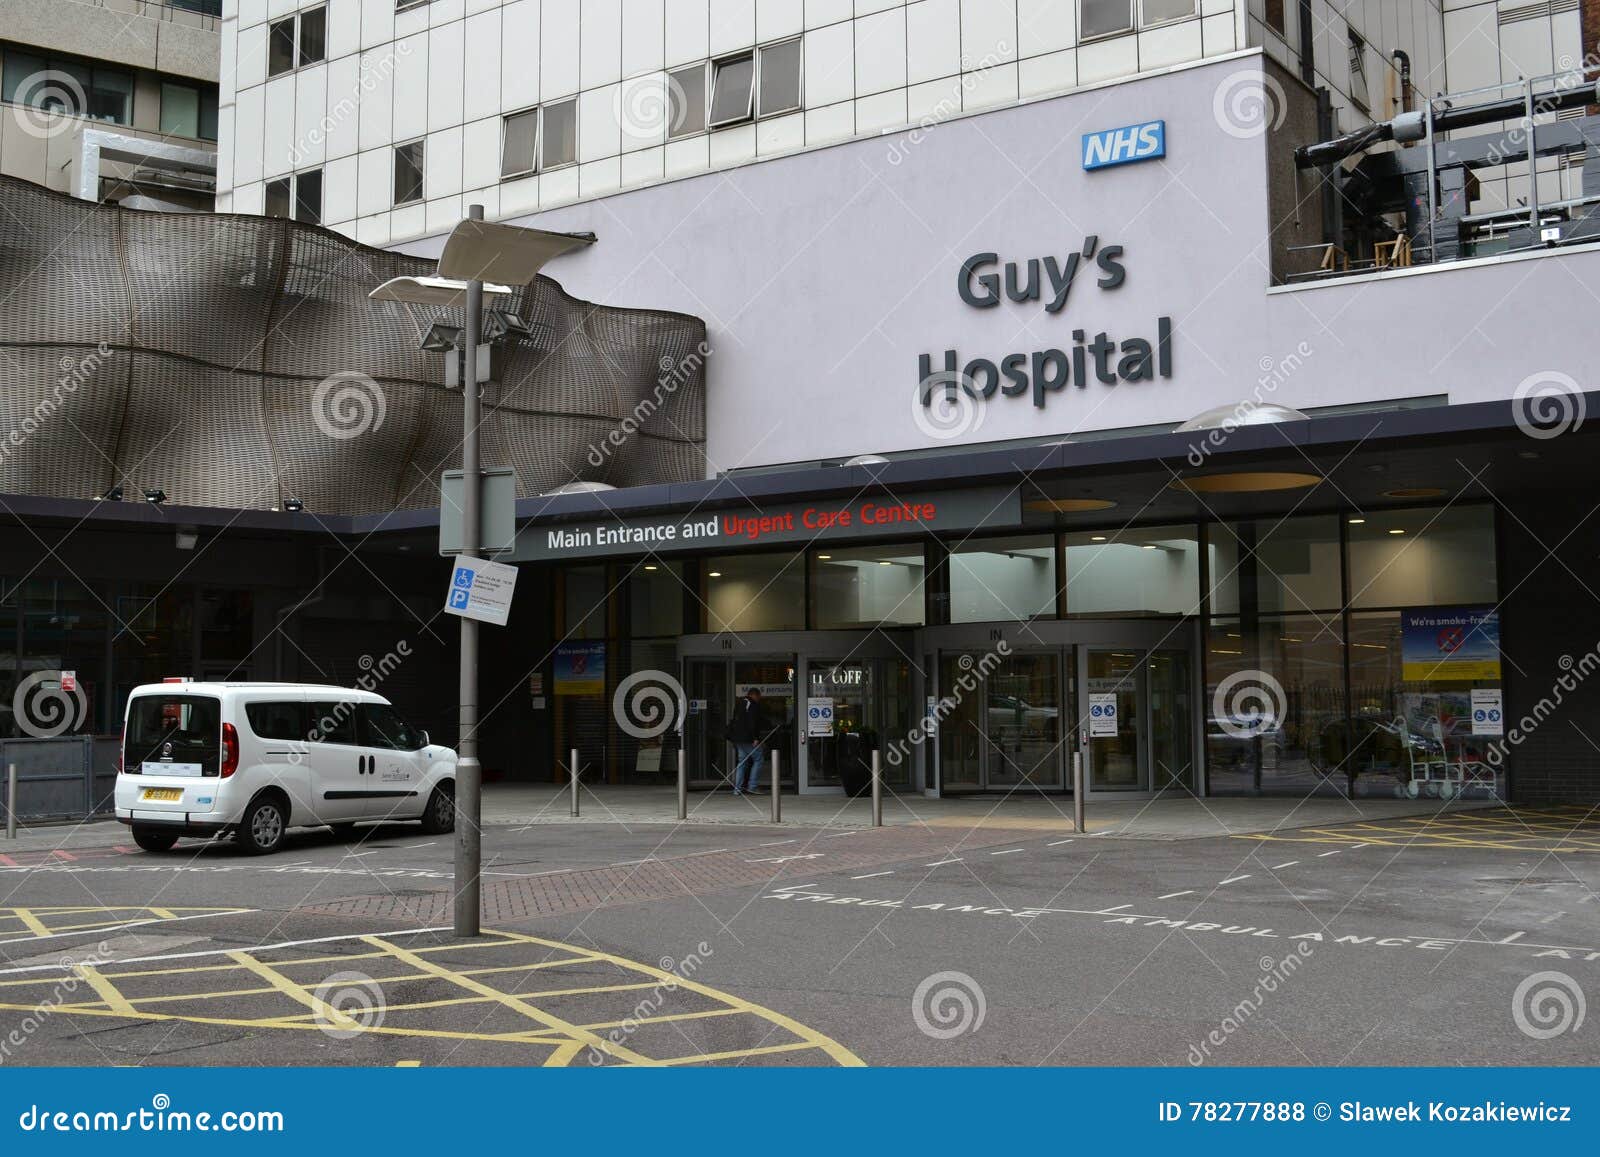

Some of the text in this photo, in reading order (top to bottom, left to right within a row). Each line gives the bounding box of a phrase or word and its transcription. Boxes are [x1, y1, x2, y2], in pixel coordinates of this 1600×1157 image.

[1083, 123, 1160, 165] NHS
[957, 235, 1127, 314] Guy's
[918, 316, 1173, 409] Hospital
[547, 501, 937, 549] Main Entrance and Urgent Care Centre
[990, 629, 1002, 640] IN
[1410, 616, 1435, 626] We're
[722, 639, 732, 650] IN
[762, 893, 1044, 918] AMBULANCE
[1103, 917, 1458, 950] AMBULANCE
